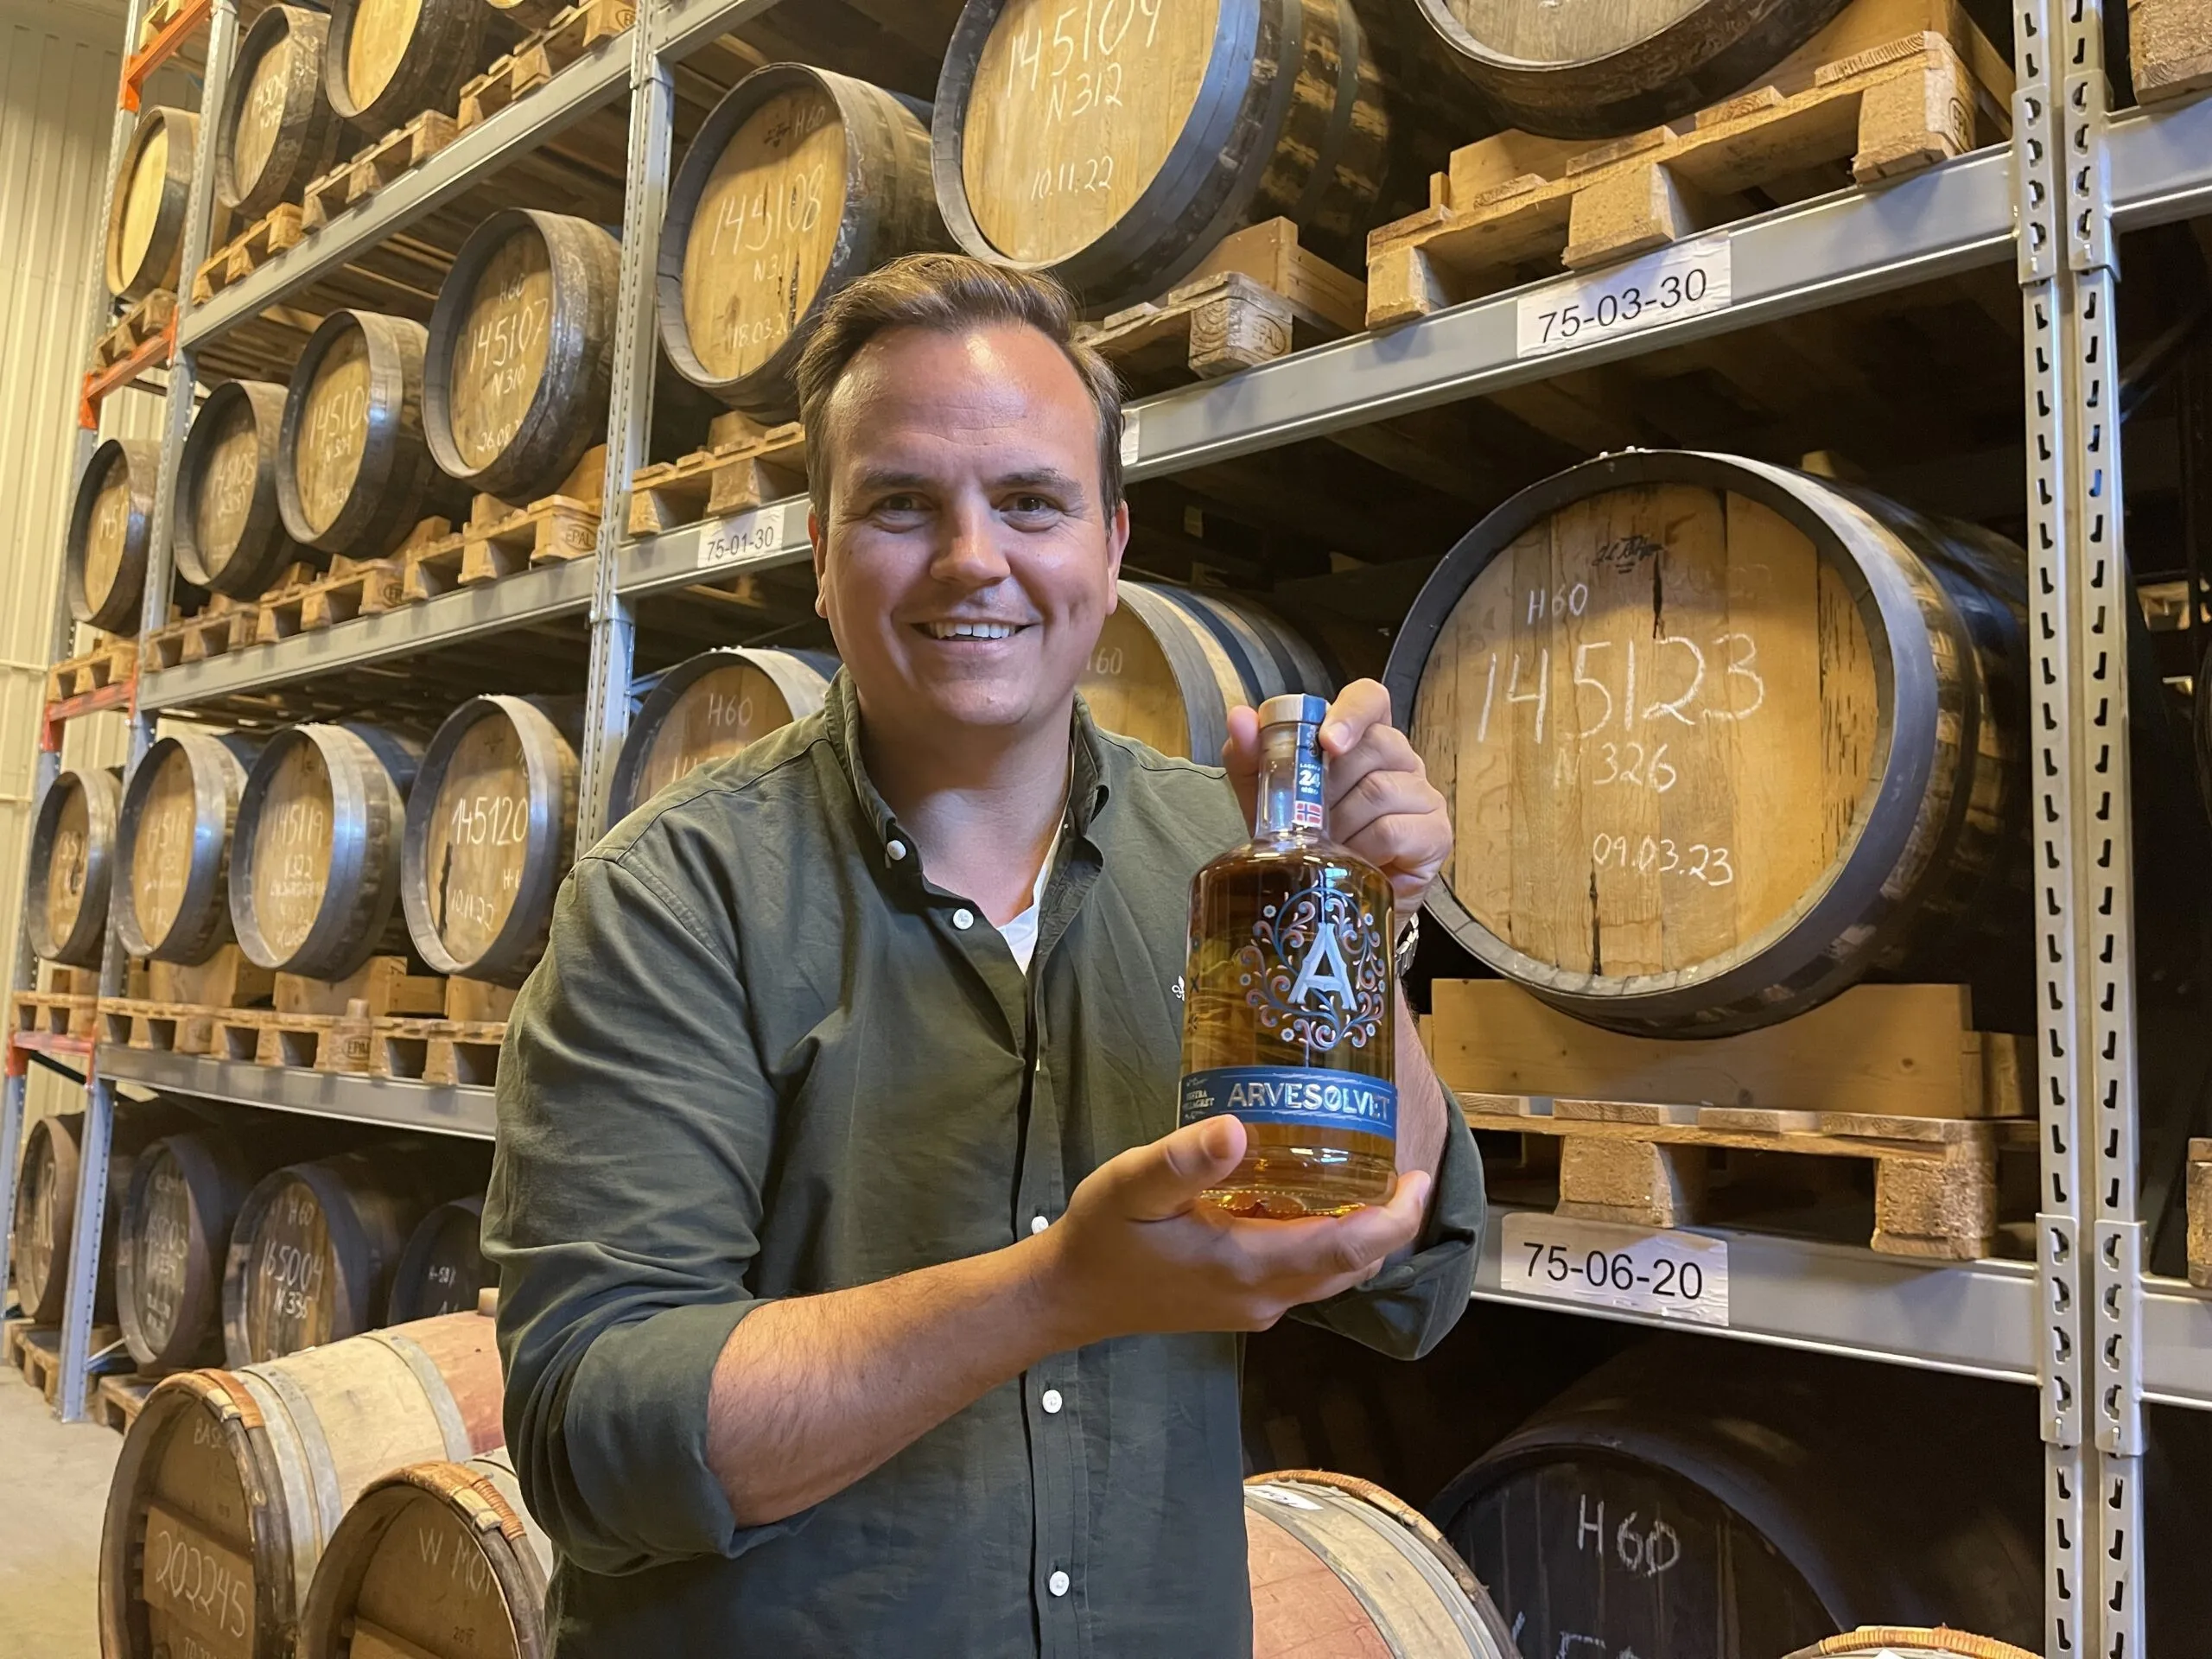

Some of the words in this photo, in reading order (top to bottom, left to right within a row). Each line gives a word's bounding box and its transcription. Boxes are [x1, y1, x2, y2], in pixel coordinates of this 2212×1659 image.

[1031, 156, 1115, 201] 10.11.22
[709, 162, 826, 256] 145108
[1538, 268, 1708, 345] 75-03-30
[469, 297, 550, 373] 145107
[706, 524, 775, 562] 75-01-30
[1526, 582, 1589, 626] H60
[708, 692, 754, 728] H60
[1477, 632, 1765, 745] 145123
[1299, 769, 1321, 788] 24
[270, 802, 324, 849] 145119
[451, 796, 529, 847] 145120
[1592, 832, 1734, 887] 09.03.23
[1287, 921, 1358, 1012] A
[1226, 1082, 1391, 1122] ARVESØLVET
[261, 1238, 325, 1301] 165004
[1523, 1241, 1703, 1300] 75-06-20
[418, 1526, 445, 1566] W
[156, 1530, 247, 1638] 202245
